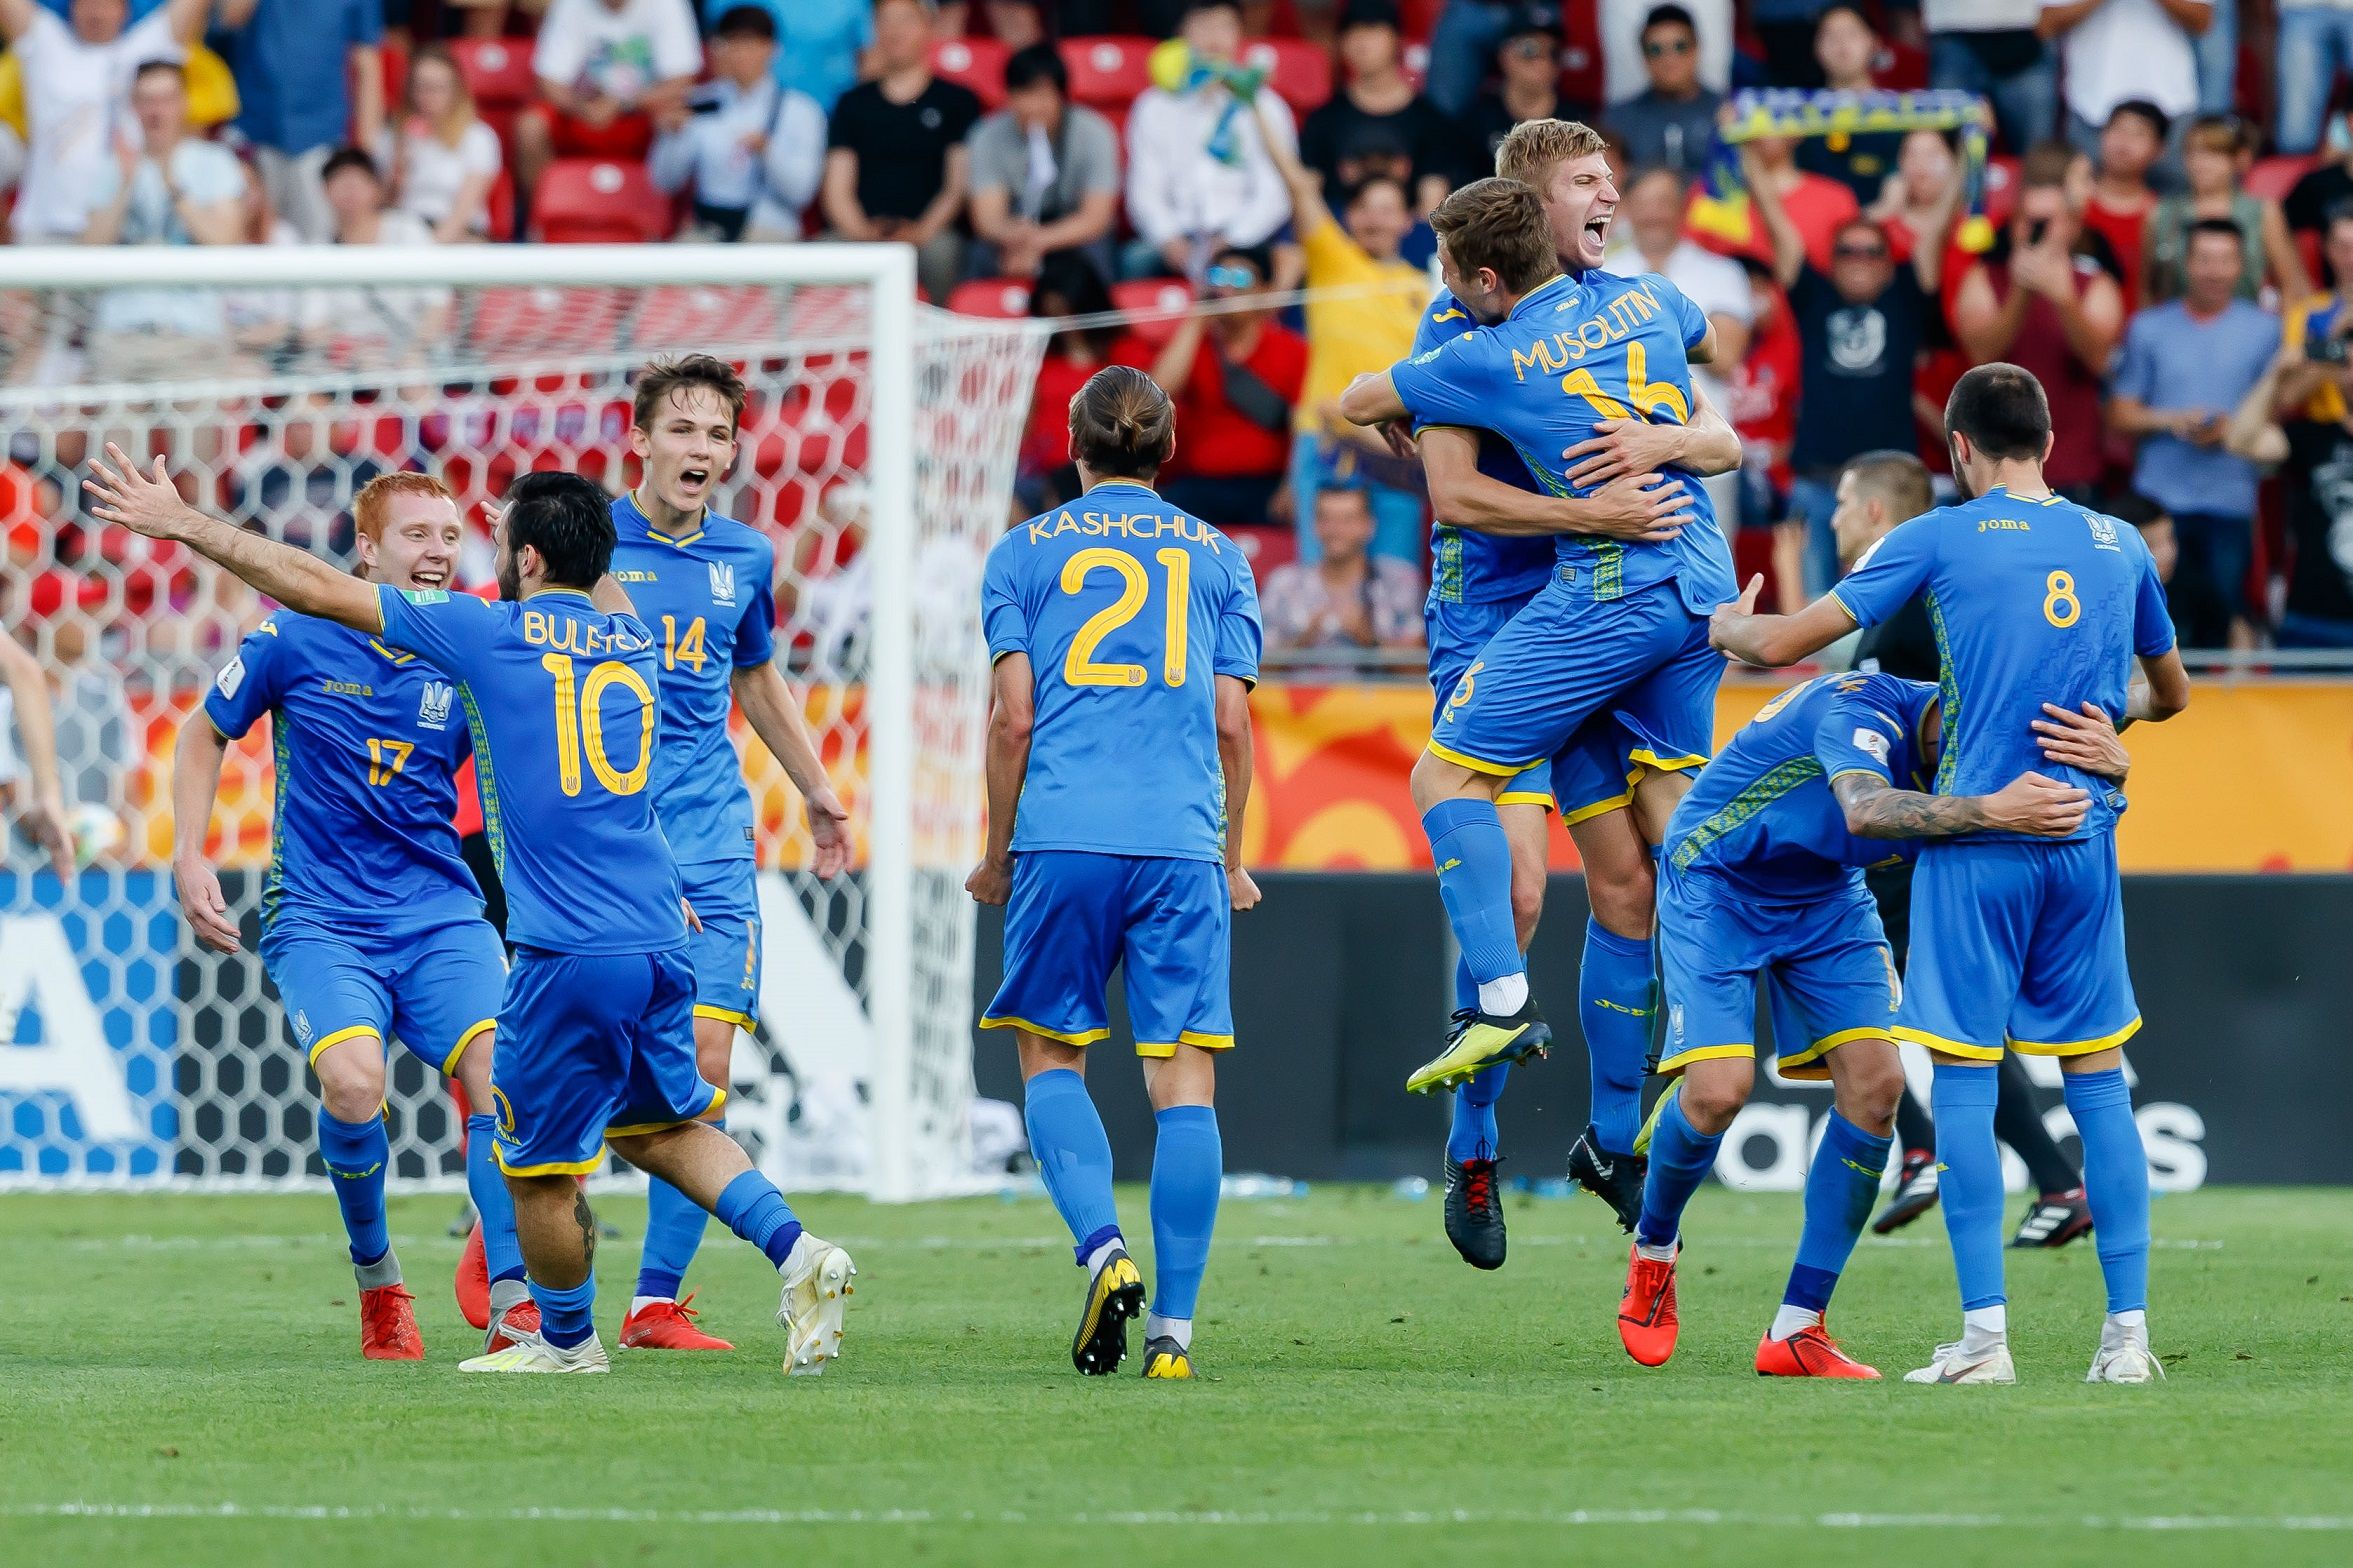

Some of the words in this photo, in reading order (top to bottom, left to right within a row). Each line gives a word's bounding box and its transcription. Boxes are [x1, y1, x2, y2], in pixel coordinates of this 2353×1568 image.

[1511, 281, 1662, 382] MUSOLITIN
[1028, 510, 1220, 555] KASHCHUK
[611, 570, 658, 582] oma
[2043, 569, 2081, 629] 8
[661, 614, 708, 672] 14
[1060, 547, 1191, 688] 21
[541, 652, 655, 797] 10
[366, 737, 415, 787] 17
